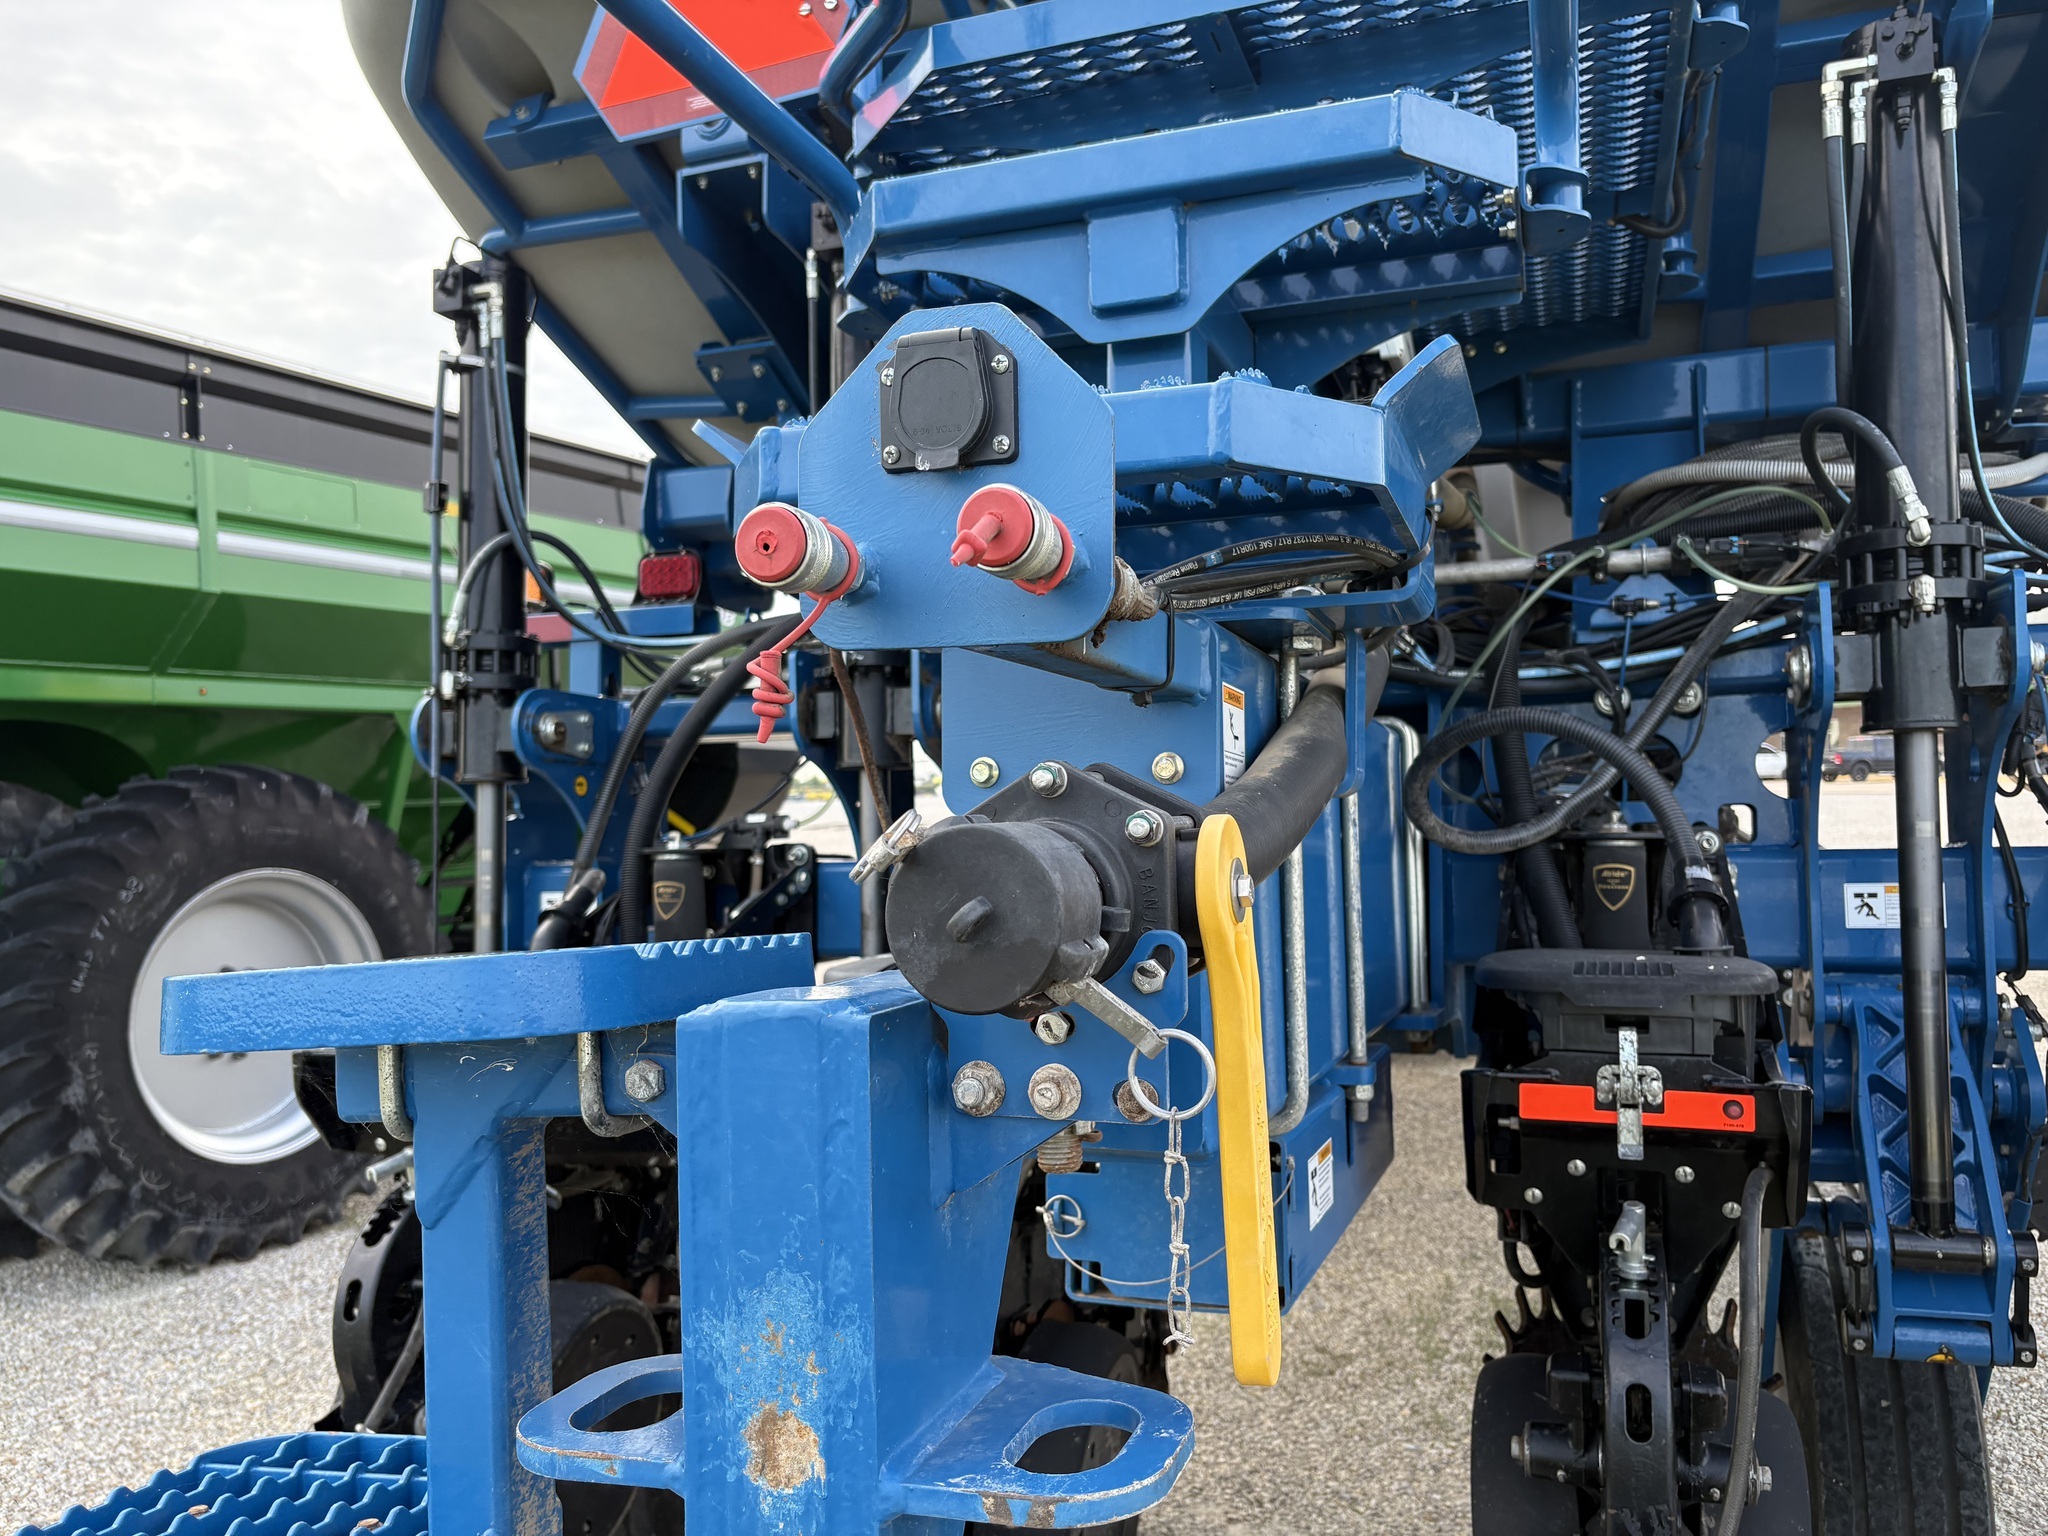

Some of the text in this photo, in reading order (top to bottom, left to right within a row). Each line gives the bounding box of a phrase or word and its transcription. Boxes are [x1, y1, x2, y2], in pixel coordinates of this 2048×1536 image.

[1258, 539, 1273, 550] SAE
[1279, 537, 1292, 546] R17
[1232, 543, 1258, 556] 100R17
[1179, 560, 1199, 573] Flame
[1153, 568, 1181, 584] Resistant
